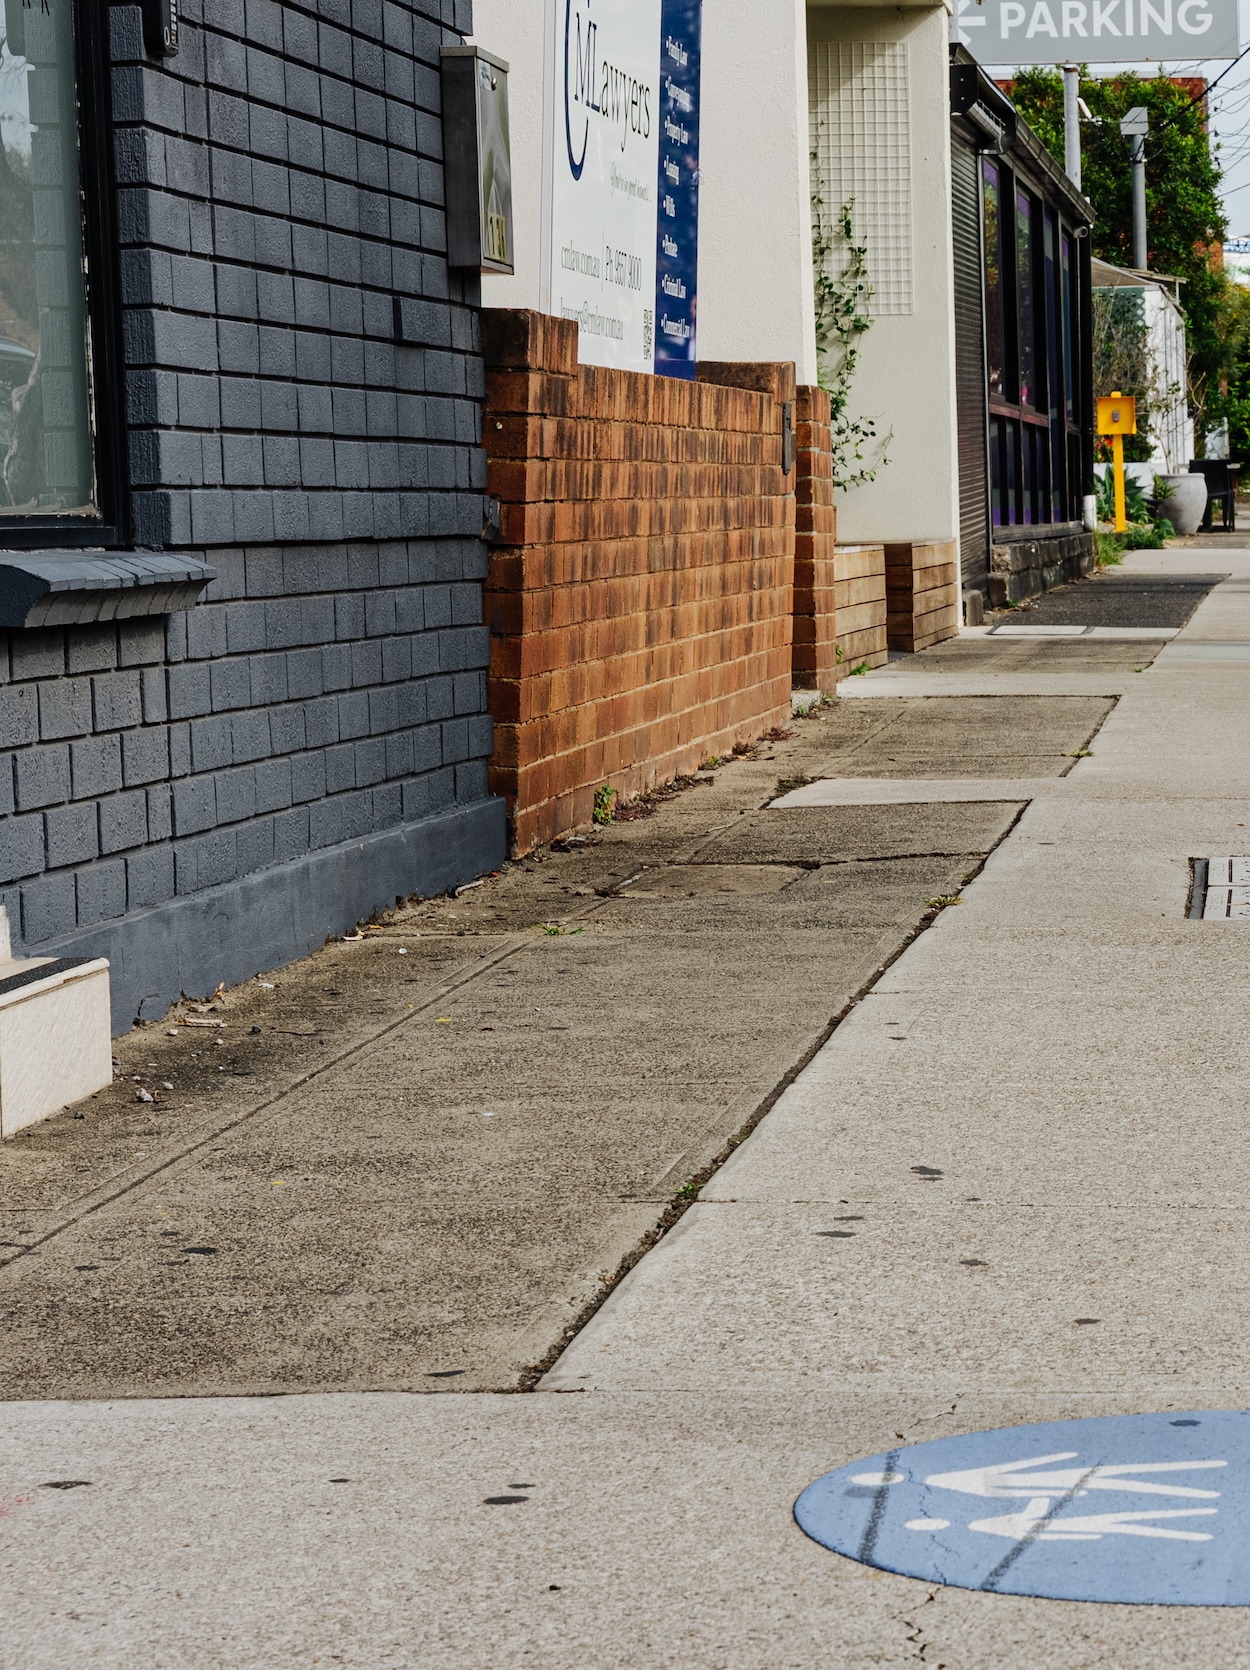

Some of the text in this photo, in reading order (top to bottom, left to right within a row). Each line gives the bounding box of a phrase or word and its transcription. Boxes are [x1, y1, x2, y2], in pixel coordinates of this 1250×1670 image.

[1000, 0, 1213, 39] PARKING
[680, 43, 688, 66] Law
[681, 122, 689, 145] Law
